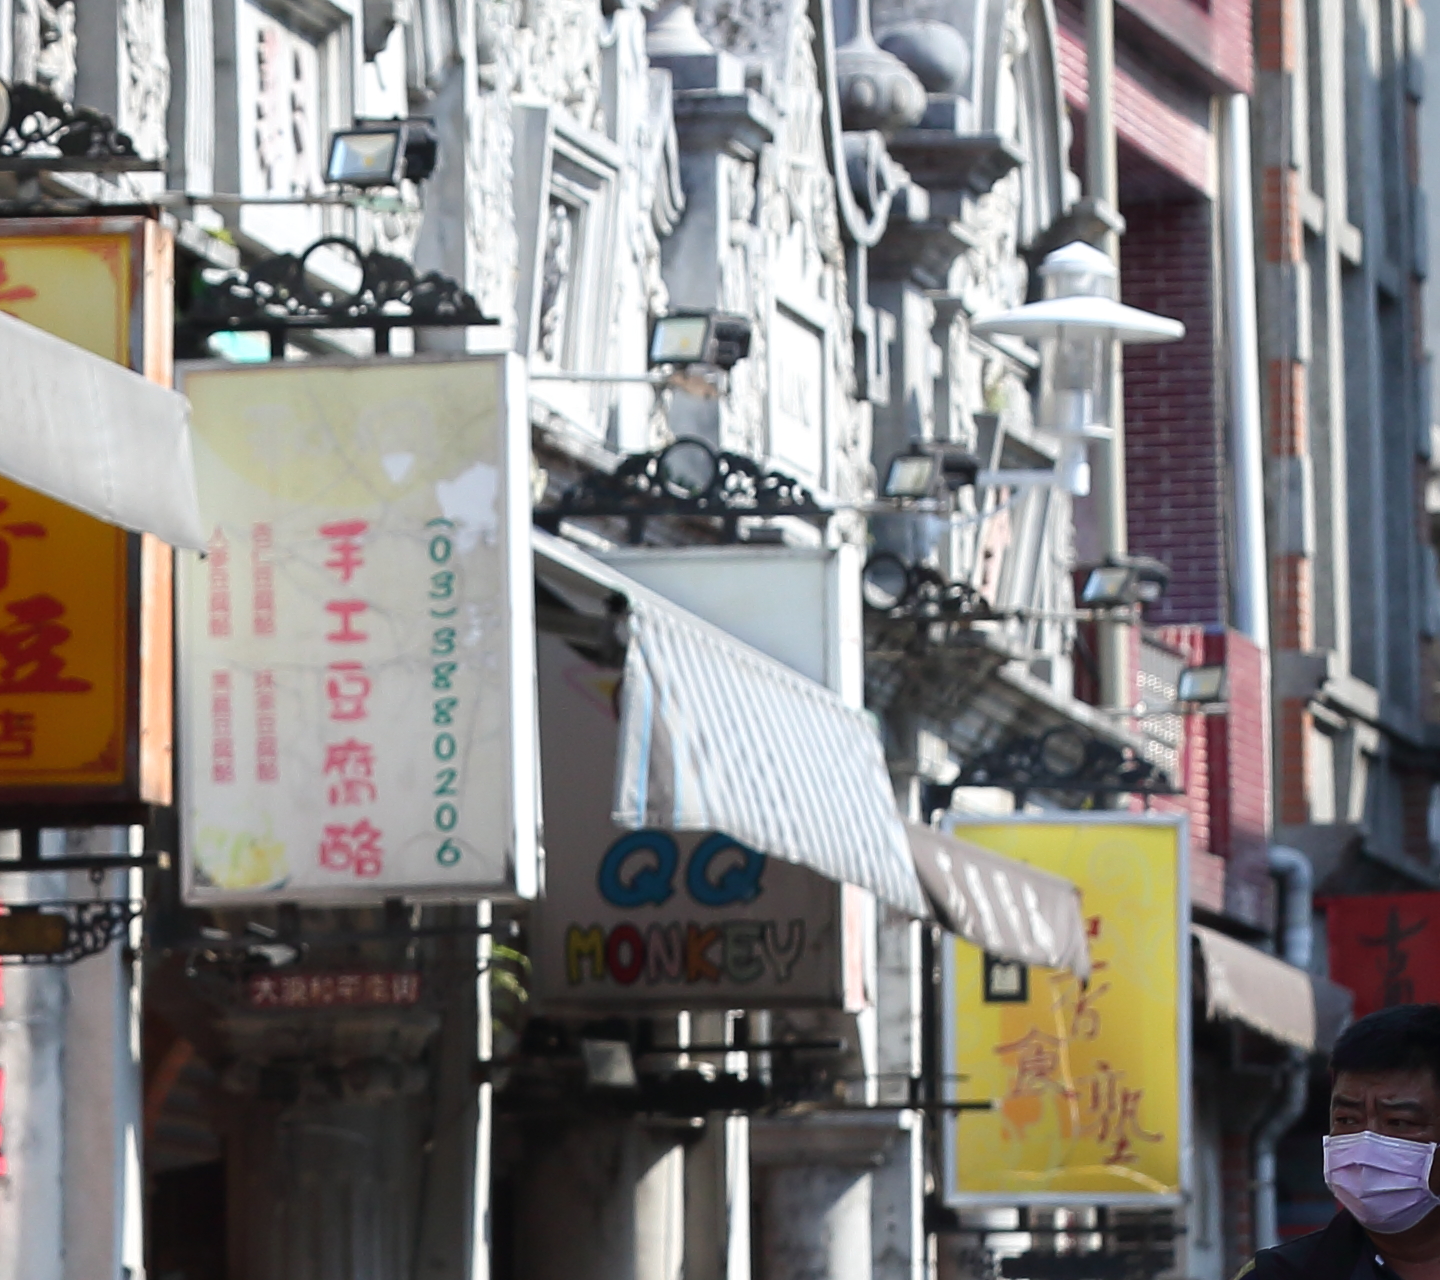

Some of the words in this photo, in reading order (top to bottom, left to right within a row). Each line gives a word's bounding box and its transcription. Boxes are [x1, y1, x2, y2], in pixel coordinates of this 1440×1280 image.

[316, 518, 387, 880] 手工豆腐酪
[597, 830, 768, 910] QQ
[566, 920, 808, 986] MONKEY
